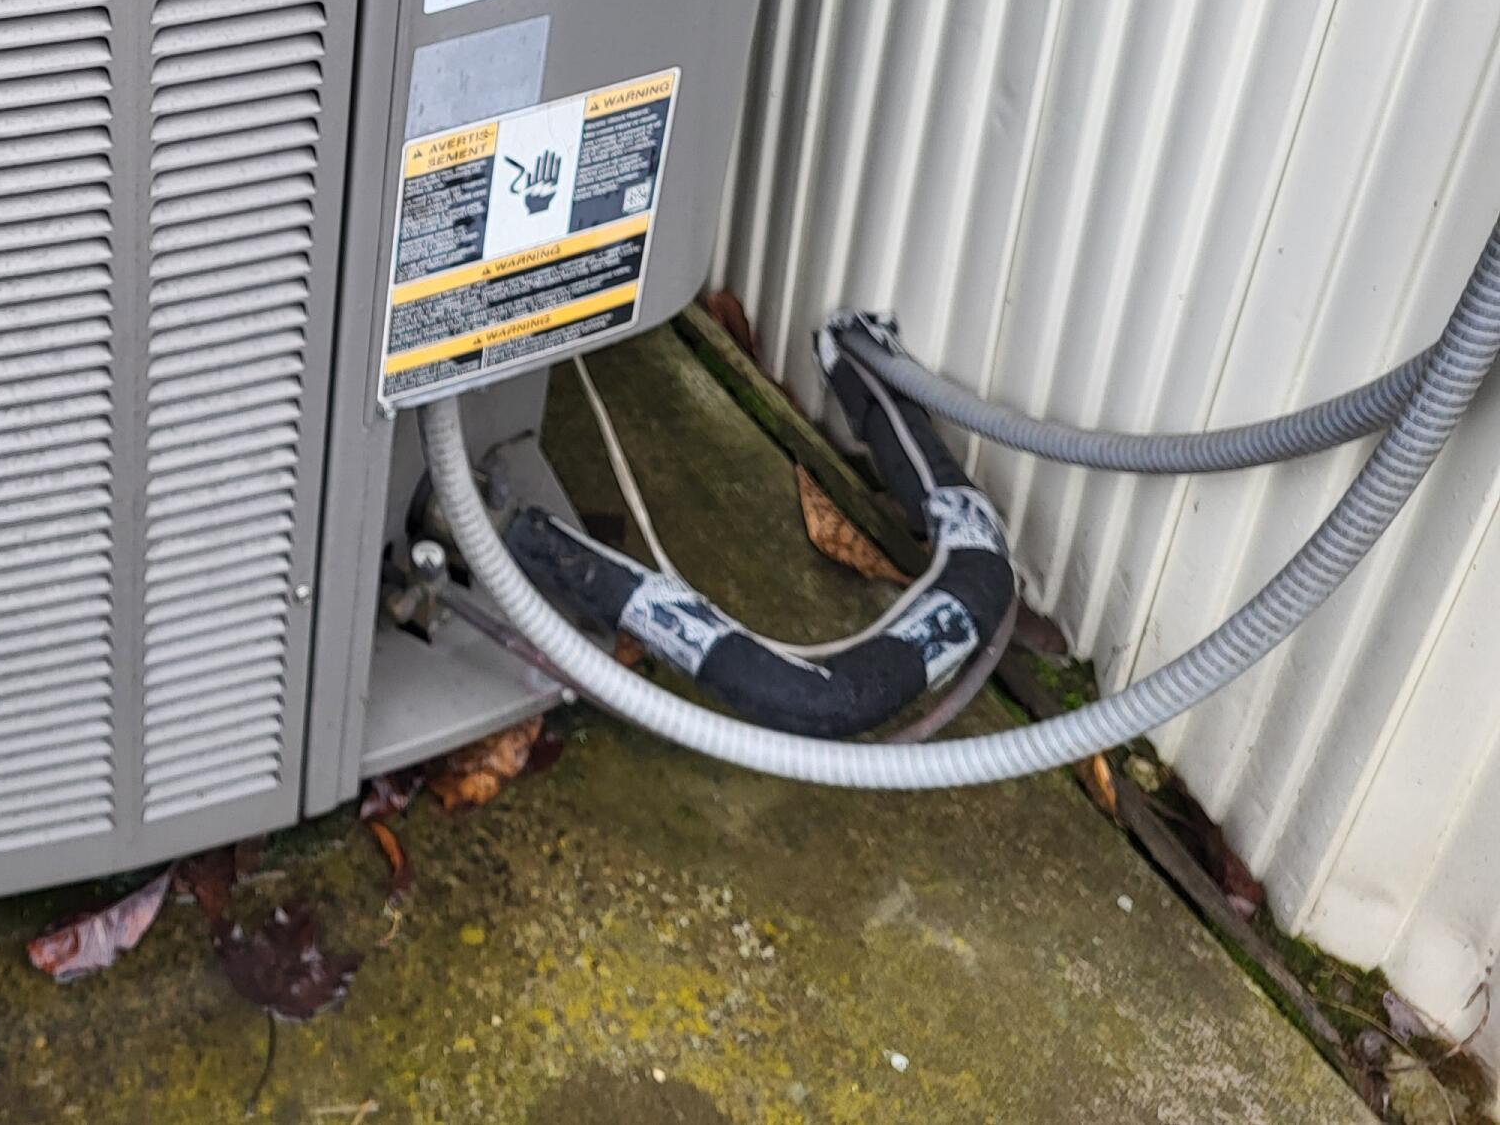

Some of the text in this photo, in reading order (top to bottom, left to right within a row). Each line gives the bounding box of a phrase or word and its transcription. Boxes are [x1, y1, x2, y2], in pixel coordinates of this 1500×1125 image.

[603, 81, 670, 108] WARNING
[428, 128, 496, 154] AVERTIS-
[427, 144, 488, 169] SEMENT
[494, 245, 562, 271] WARNING
[485, 316, 551, 342] WARNING
